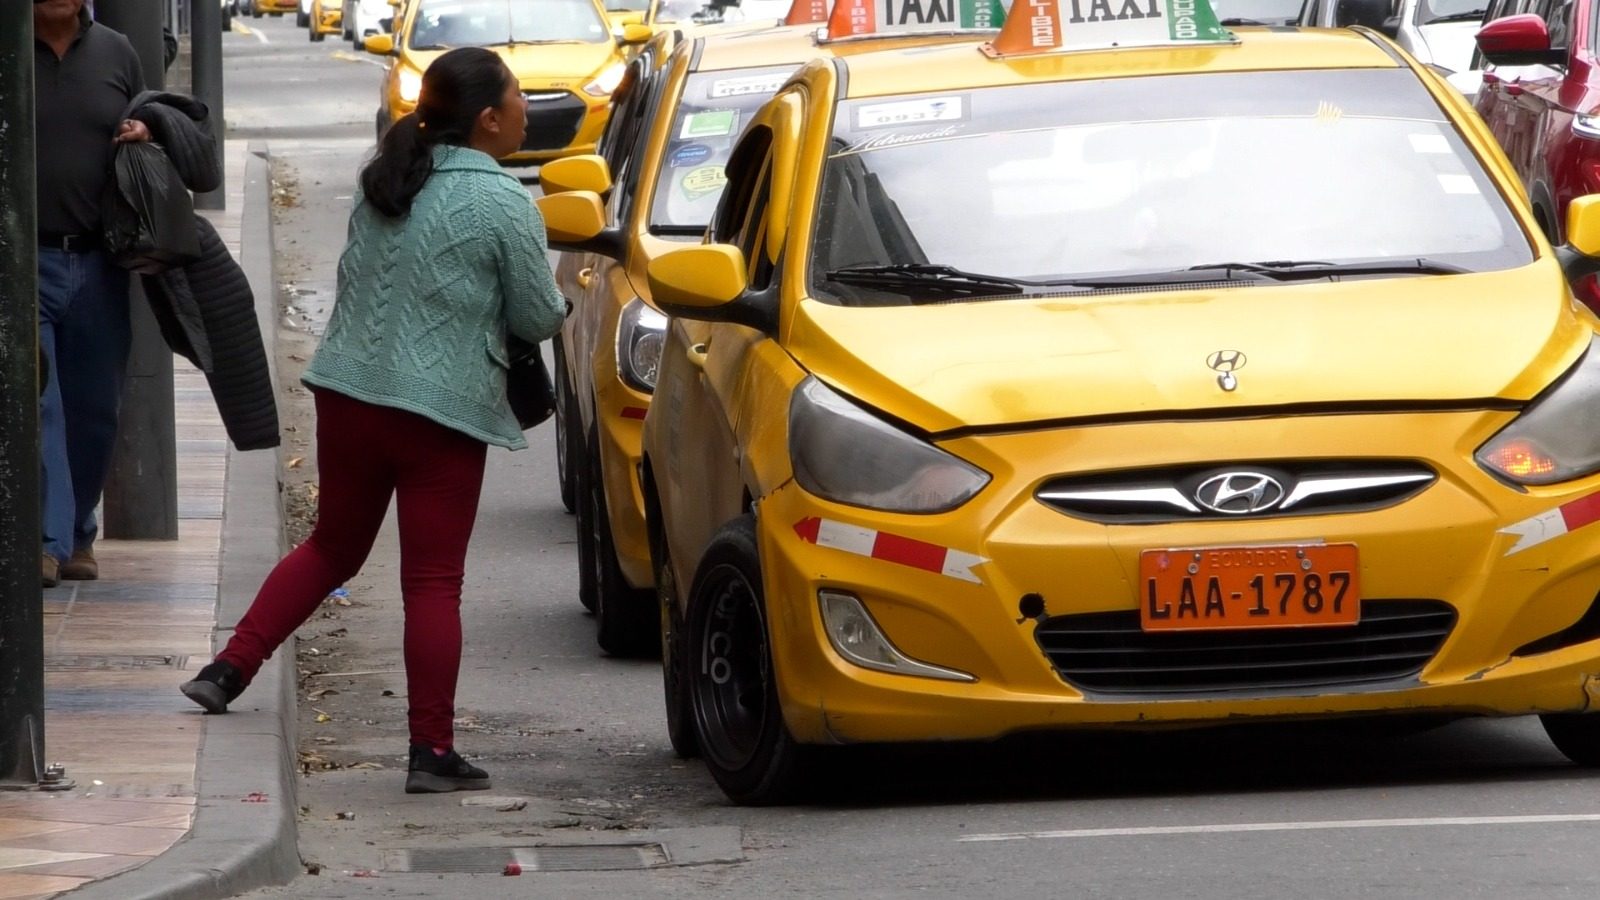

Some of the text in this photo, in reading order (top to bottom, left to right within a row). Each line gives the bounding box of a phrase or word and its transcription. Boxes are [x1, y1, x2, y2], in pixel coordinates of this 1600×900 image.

[886, 0, 955, 26] TAXI
[1069, 0, 1162, 24] TAXI
[1208, 550, 1289, 568] ECUADOR
[1148, 572, 1351, 620] LAA-1787
